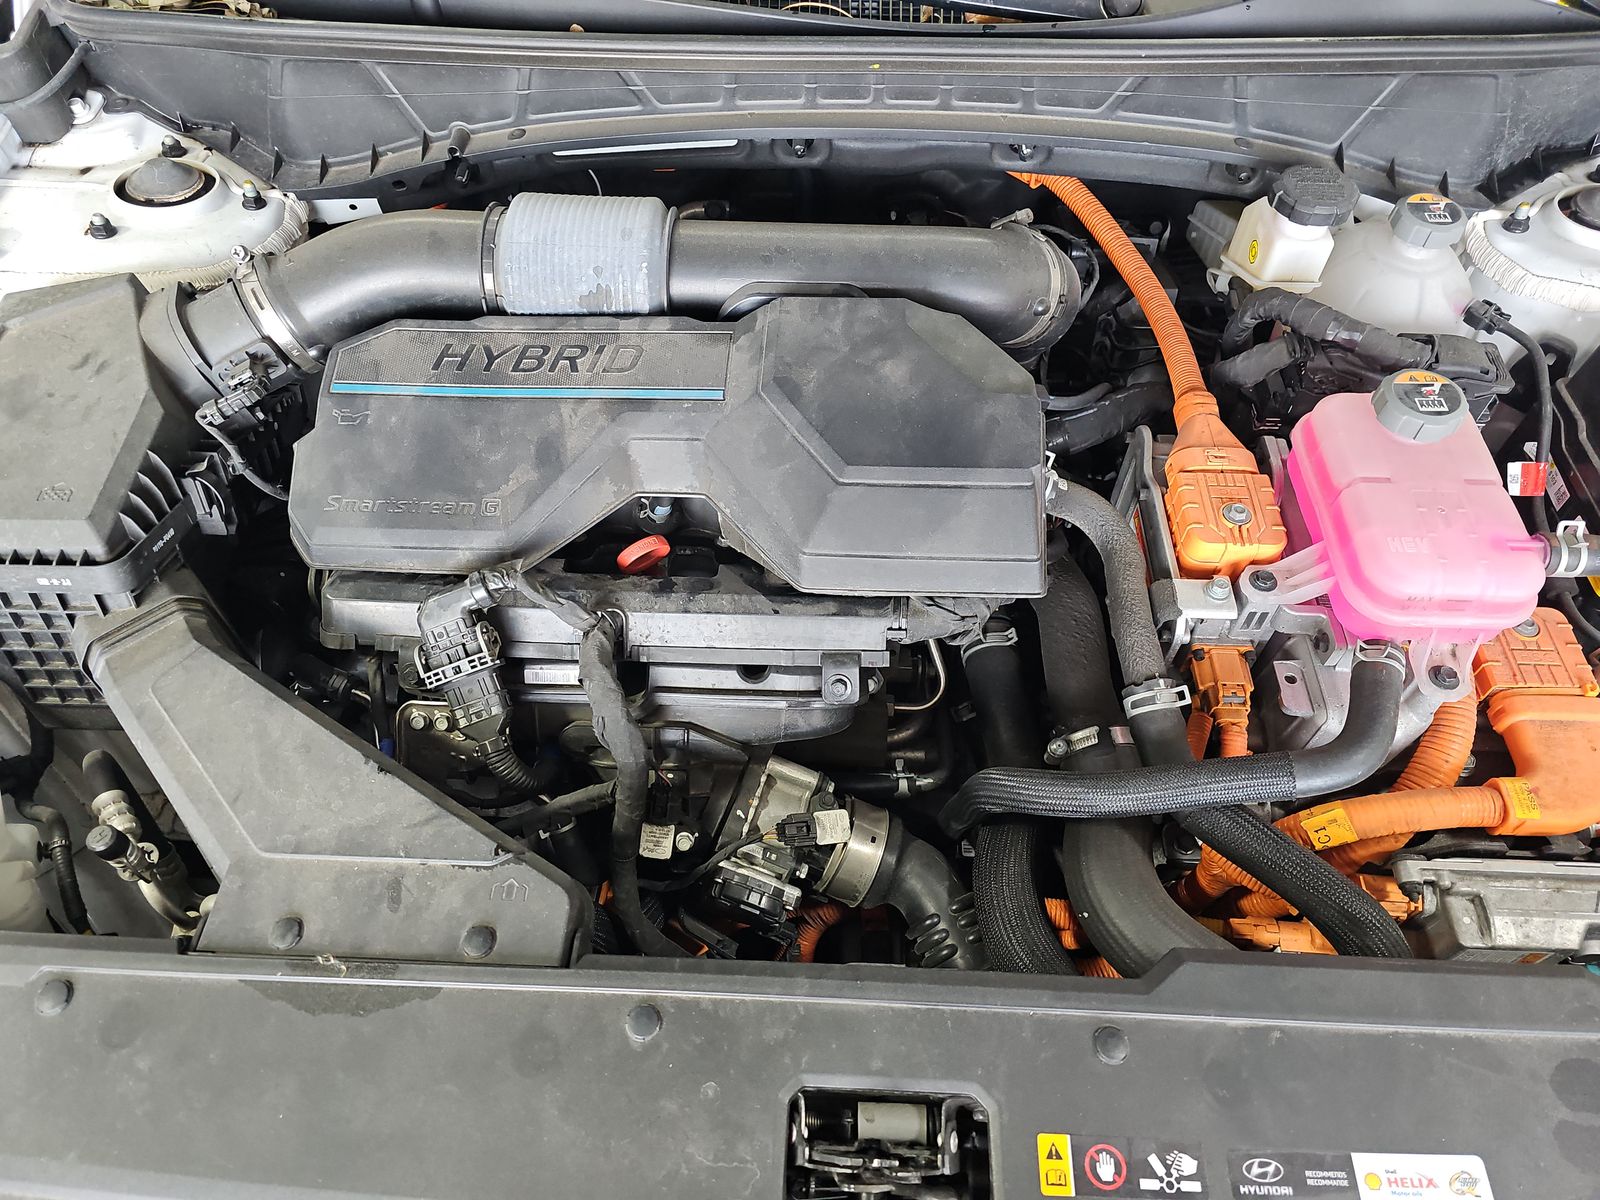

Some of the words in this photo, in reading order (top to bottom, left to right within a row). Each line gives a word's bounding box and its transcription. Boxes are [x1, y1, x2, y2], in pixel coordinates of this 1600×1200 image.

[431, 343, 647, 374] HYBRID
[323, 495, 476, 515] Smartstream
[483, 498, 501, 516] G
[1385, 536, 1430, 554] HEV
[1522, 782, 1538, 810] PASS
[1304, 1169, 1348, 1179] RECOMMENDS
[1386, 1176, 1438, 1190] HELIX
[1239, 1184, 1294, 1196] HYUNDAI
